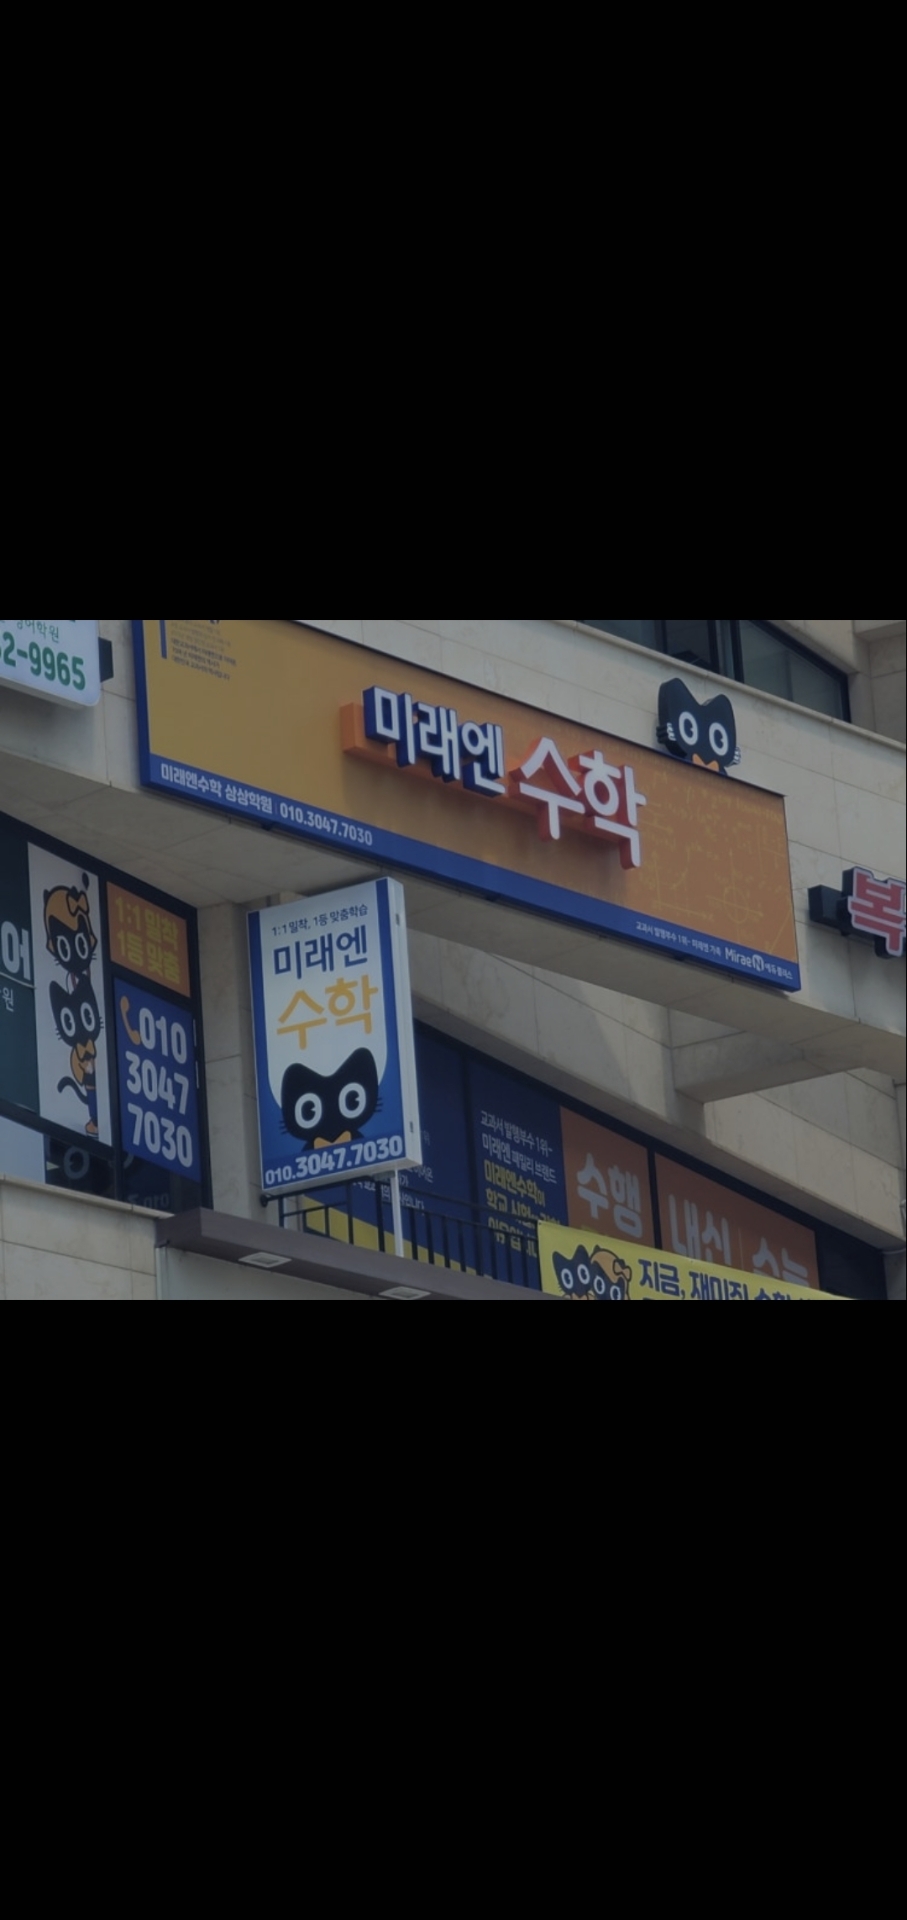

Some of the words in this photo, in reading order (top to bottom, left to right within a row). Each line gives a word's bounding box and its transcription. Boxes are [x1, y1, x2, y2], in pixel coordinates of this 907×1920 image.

[0, 631, 86, 691] 2-9965
[372, 685, 506, 794] 미래엔
[519, 736, 647, 868] 수학
[160, 763, 222, 798] 미래엔수학
[224, 783, 273, 815] 상상학원
[279, 801, 373, 847] 010.3047.7030
[115, 896, 141, 932] 1:1
[144, 907, 179, 951] 밀착
[271, 924, 287, 937] 1:1
[288, 917, 312, 934] 밀착,
[312, 912, 329, 927] 1등
[329, 903, 369, 924] 맞춤학습
[117, 929, 144, 968] 1등
[146, 941, 181, 985] 맞춤
[272, 924, 368, 980] 미래엔
[724, 946, 765, 973] MiraeN
[0, 986, 14, 1013] 원
[276, 974, 379, 1050] 수학
[138, 1007, 188, 1064] 010
[125, 1050, 189, 1115] 3047
[127, 1102, 193, 1168] 7030
[480, 1110, 505, 1137] 교과서
[503, 1120, 536, 1151] 발행부수
[481, 1131, 512, 1165] 미래엔
[511, 1150, 535, 1175] 패밀리
[534, 1160, 558, 1184] 브랜드
[265, 1135, 403, 1185] 010.3047.7030
[484, 1158, 546, 1208] 미래엔수학이
[485, 1187, 508, 1213] 학교
[577, 1152, 643, 1239] 수행
[668, 1194, 732, 1266] 내신
[637, 1258, 686, 1299] 지금,
